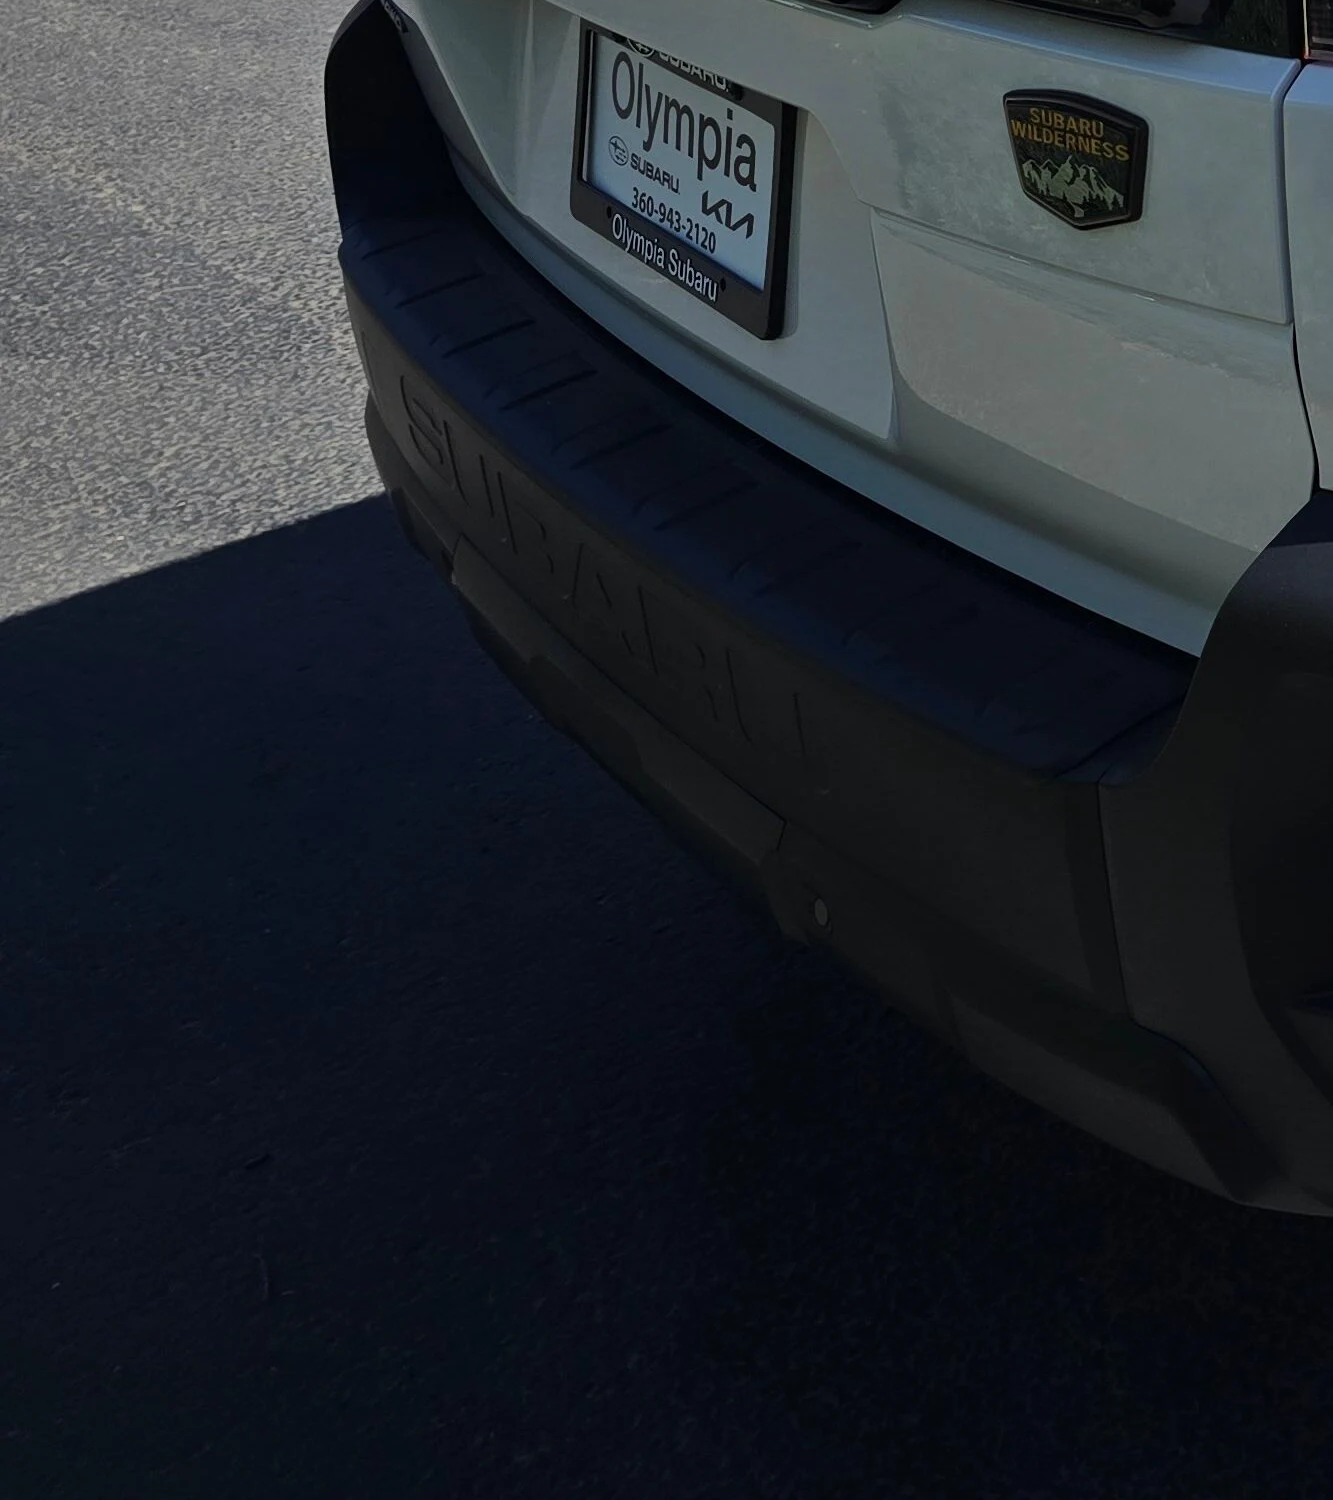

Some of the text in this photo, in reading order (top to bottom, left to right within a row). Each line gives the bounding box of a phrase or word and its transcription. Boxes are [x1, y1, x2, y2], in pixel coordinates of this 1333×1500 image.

[612, 51, 757, 192] Olympia
[1011, 120, 1130, 161] WILDERNESS
[1029, 107, 1104, 138] SUBARU
[630, 153, 680, 195] SUBARU
[632, 187, 716, 254] 360-943-2120
[612, 213, 718, 302] Olympia Subaru
